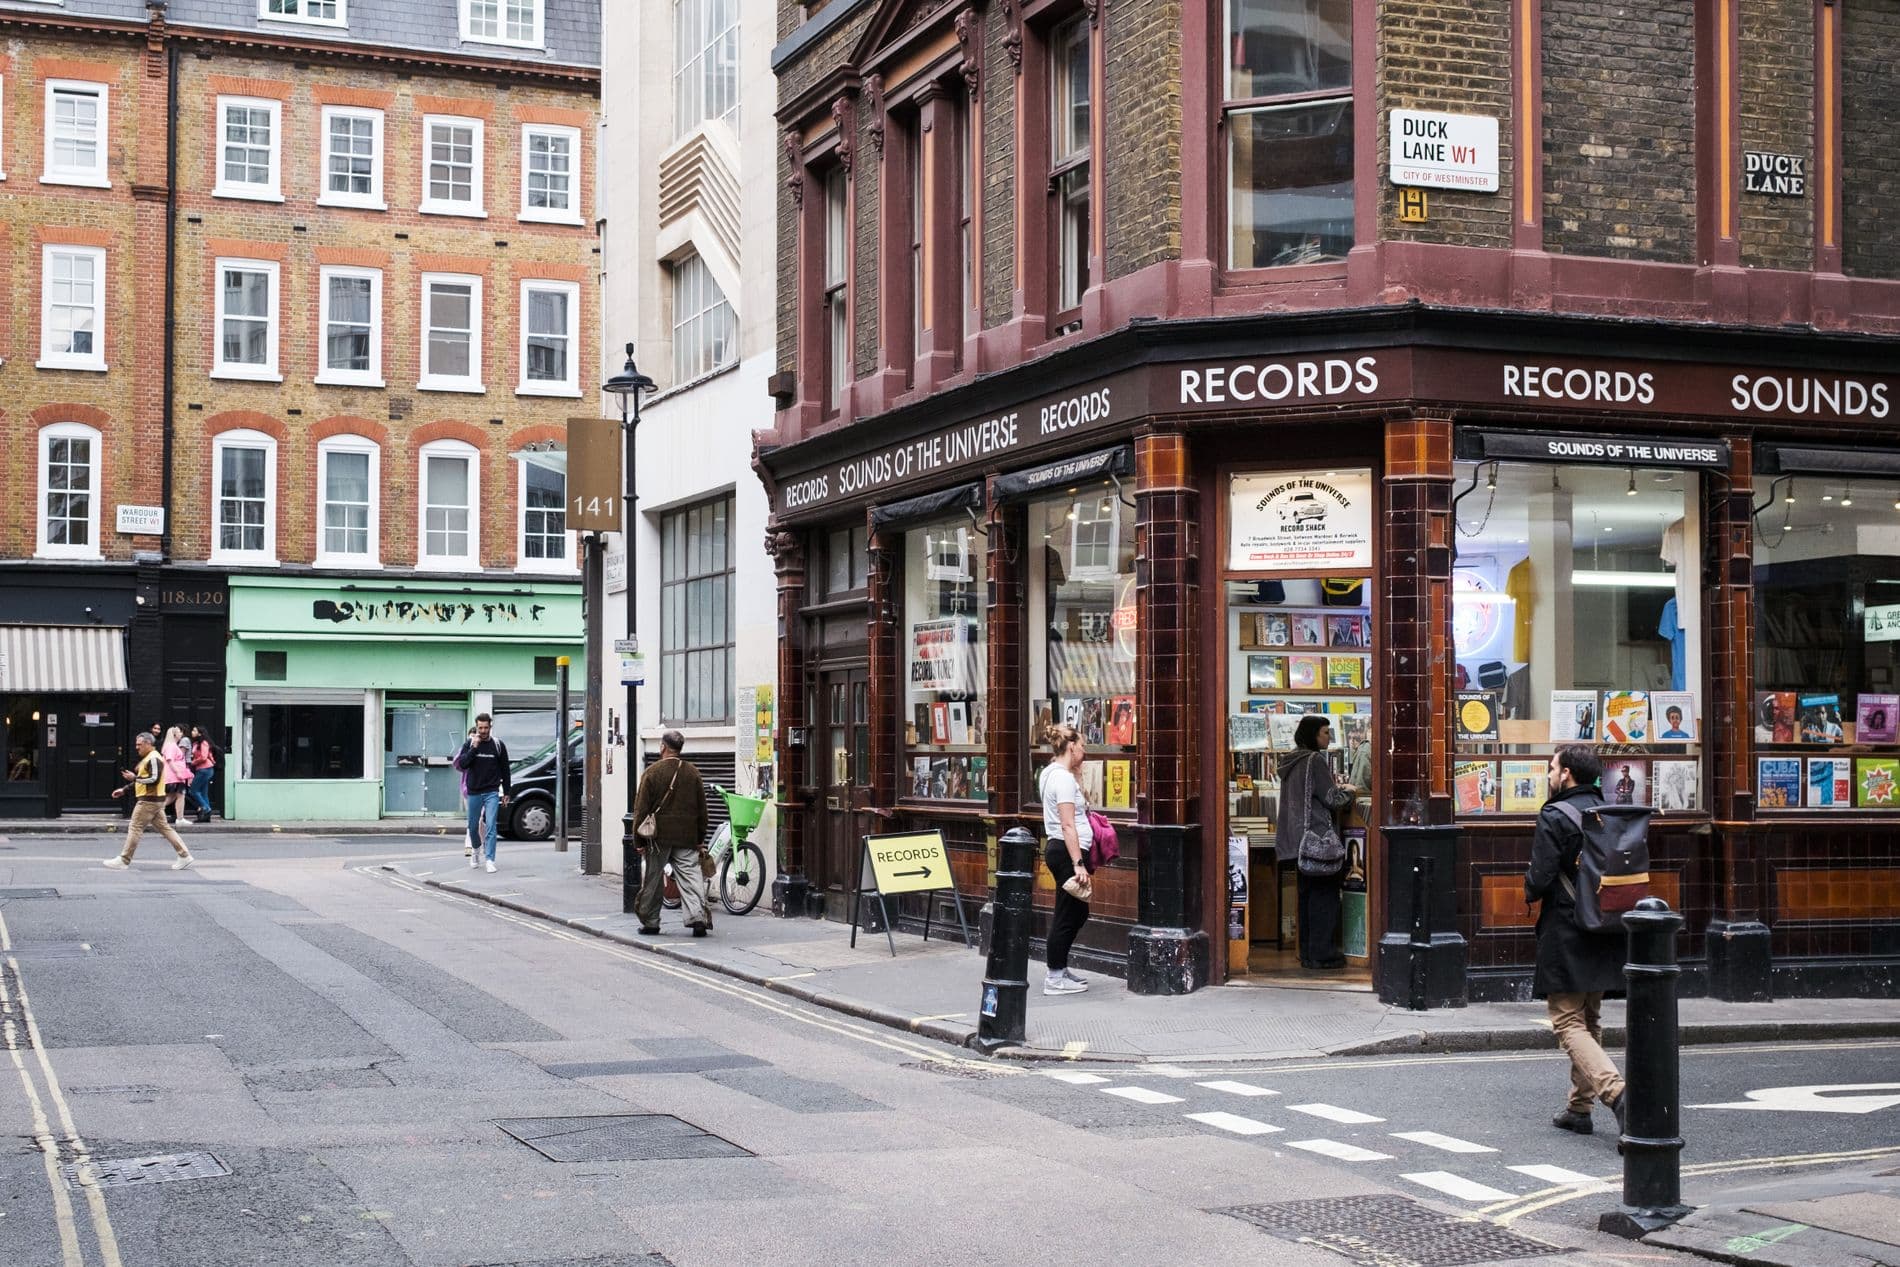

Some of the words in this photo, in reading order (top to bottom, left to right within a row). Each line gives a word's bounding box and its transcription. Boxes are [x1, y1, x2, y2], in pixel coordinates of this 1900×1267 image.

[1403, 118, 1448, 140] DUCK
[1403, 141, 1446, 162] LANE
[1451, 145, 1476, 165] W1
[1745, 154, 1804, 176] DUCK
[1403, 171, 1420, 180] CITY
[1422, 172, 1433, 181] OF
[1435, 173, 1489, 186] WESTMINSTER
[1745, 173, 1804, 195] LANE
[1180, 356, 1379, 404] RECORDS
[1503, 364, 1655, 404] RECORDS
[1731, 374, 1890, 419] SOUNDS
[785, 475, 829, 509] RECORDS
[838, 452, 892, 495] SOUNDS
[894, 446, 914, 478] OF
[916, 437, 943, 471] THE
[945, 413, 1019, 464] UNIVERSE
[1040, 387, 1111, 436] RECORDS
[1547, 441, 1604, 457] SOUNDS
[1606, 444, 1624, 458] OF
[1626, 445, 1652, 459] THE
[1653, 447, 1719, 462] UNIVERSE
[1027, 467, 1054, 485] SOUNDS
[1053, 465, 1063, 478] OF
[1063, 462, 1076, 475] THE
[1075, 453, 1110, 473] UNIVERSE
[573, 495, 613, 517] 141
[1256, 484, 1286, 512] SOUNDS
[1286, 481, 1297, 490] OF
[1299, 479, 1315, 489] THE
[1315, 481, 1352, 509] UNIVERSE
[121, 508, 158, 517] WARDOUR
[121, 517, 148, 525] STREET
[1305, 523, 1326, 531] SHACK
[1329, 662, 1360, 672] NOISE
[1762, 761, 1799, 774] CUBA
[877, 847, 939, 863] RECORDS
